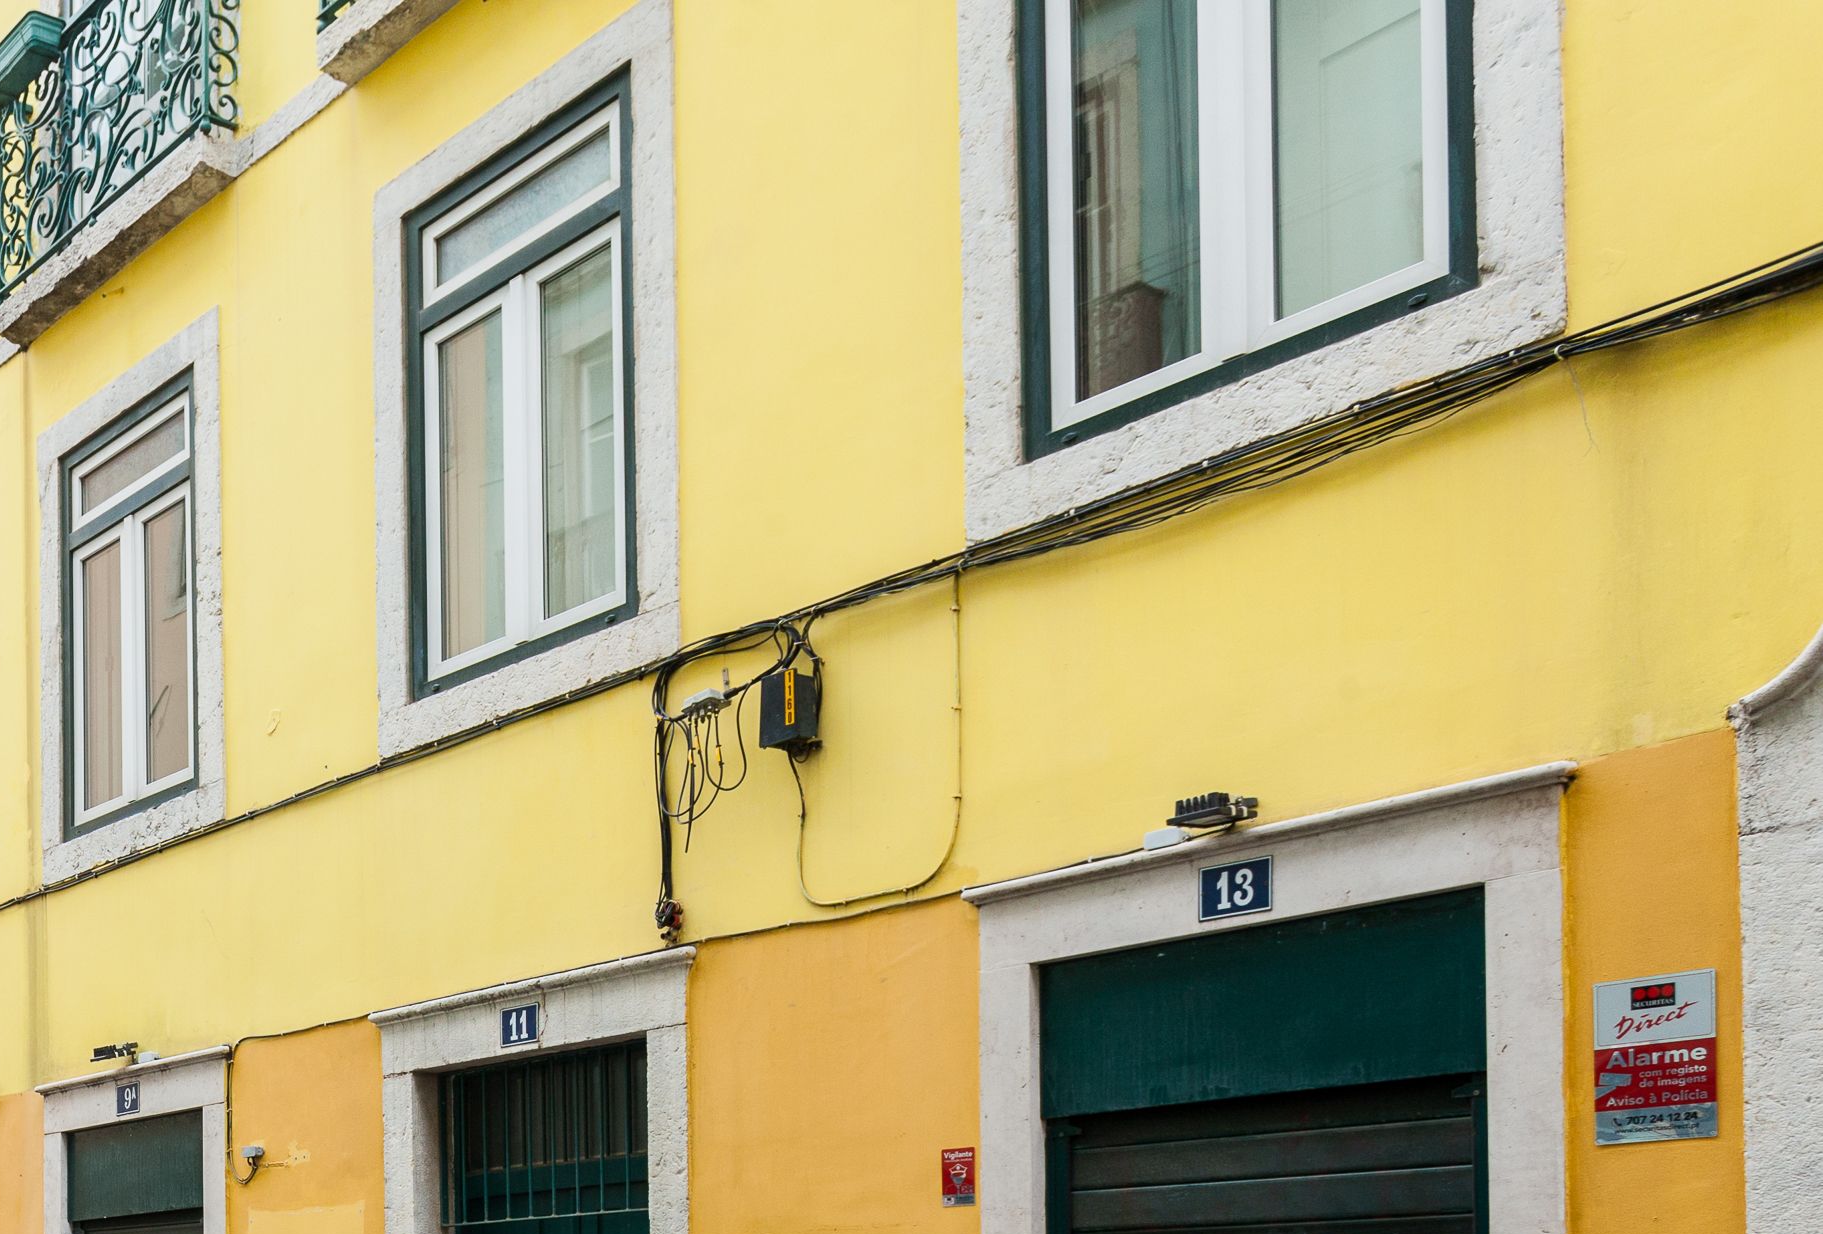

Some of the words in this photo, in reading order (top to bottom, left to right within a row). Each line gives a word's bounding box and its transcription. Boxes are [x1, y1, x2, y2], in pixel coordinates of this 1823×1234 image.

[1217, 868, 1254, 910] 13
[1632, 998, 1675, 1008] SECURITAS
[509, 1010, 529, 1041] 11
[1613, 1001, 1699, 1040] Direct
[1606, 1047, 1708, 1070] Alarme
[1639, 1070, 1663, 1078] com
[1666, 1064, 1707, 1077] registo
[1639, 1078, 1654, 1088] de
[1657, 1074, 1707, 1087] imagens
[1606, 1096, 1645, 1108] Aviso
[1649, 1093, 1657, 1104] à
[1662, 1089, 1708, 1103] Polícia
[1626, 1116, 1647, 1125] 707
[1650, 1114, 1664, 1123] 24
[1667, 1112, 1681, 1121] 12
[1684, 1111, 1698, 1120] 24
[944, 1151, 973, 1160] Vigilante
